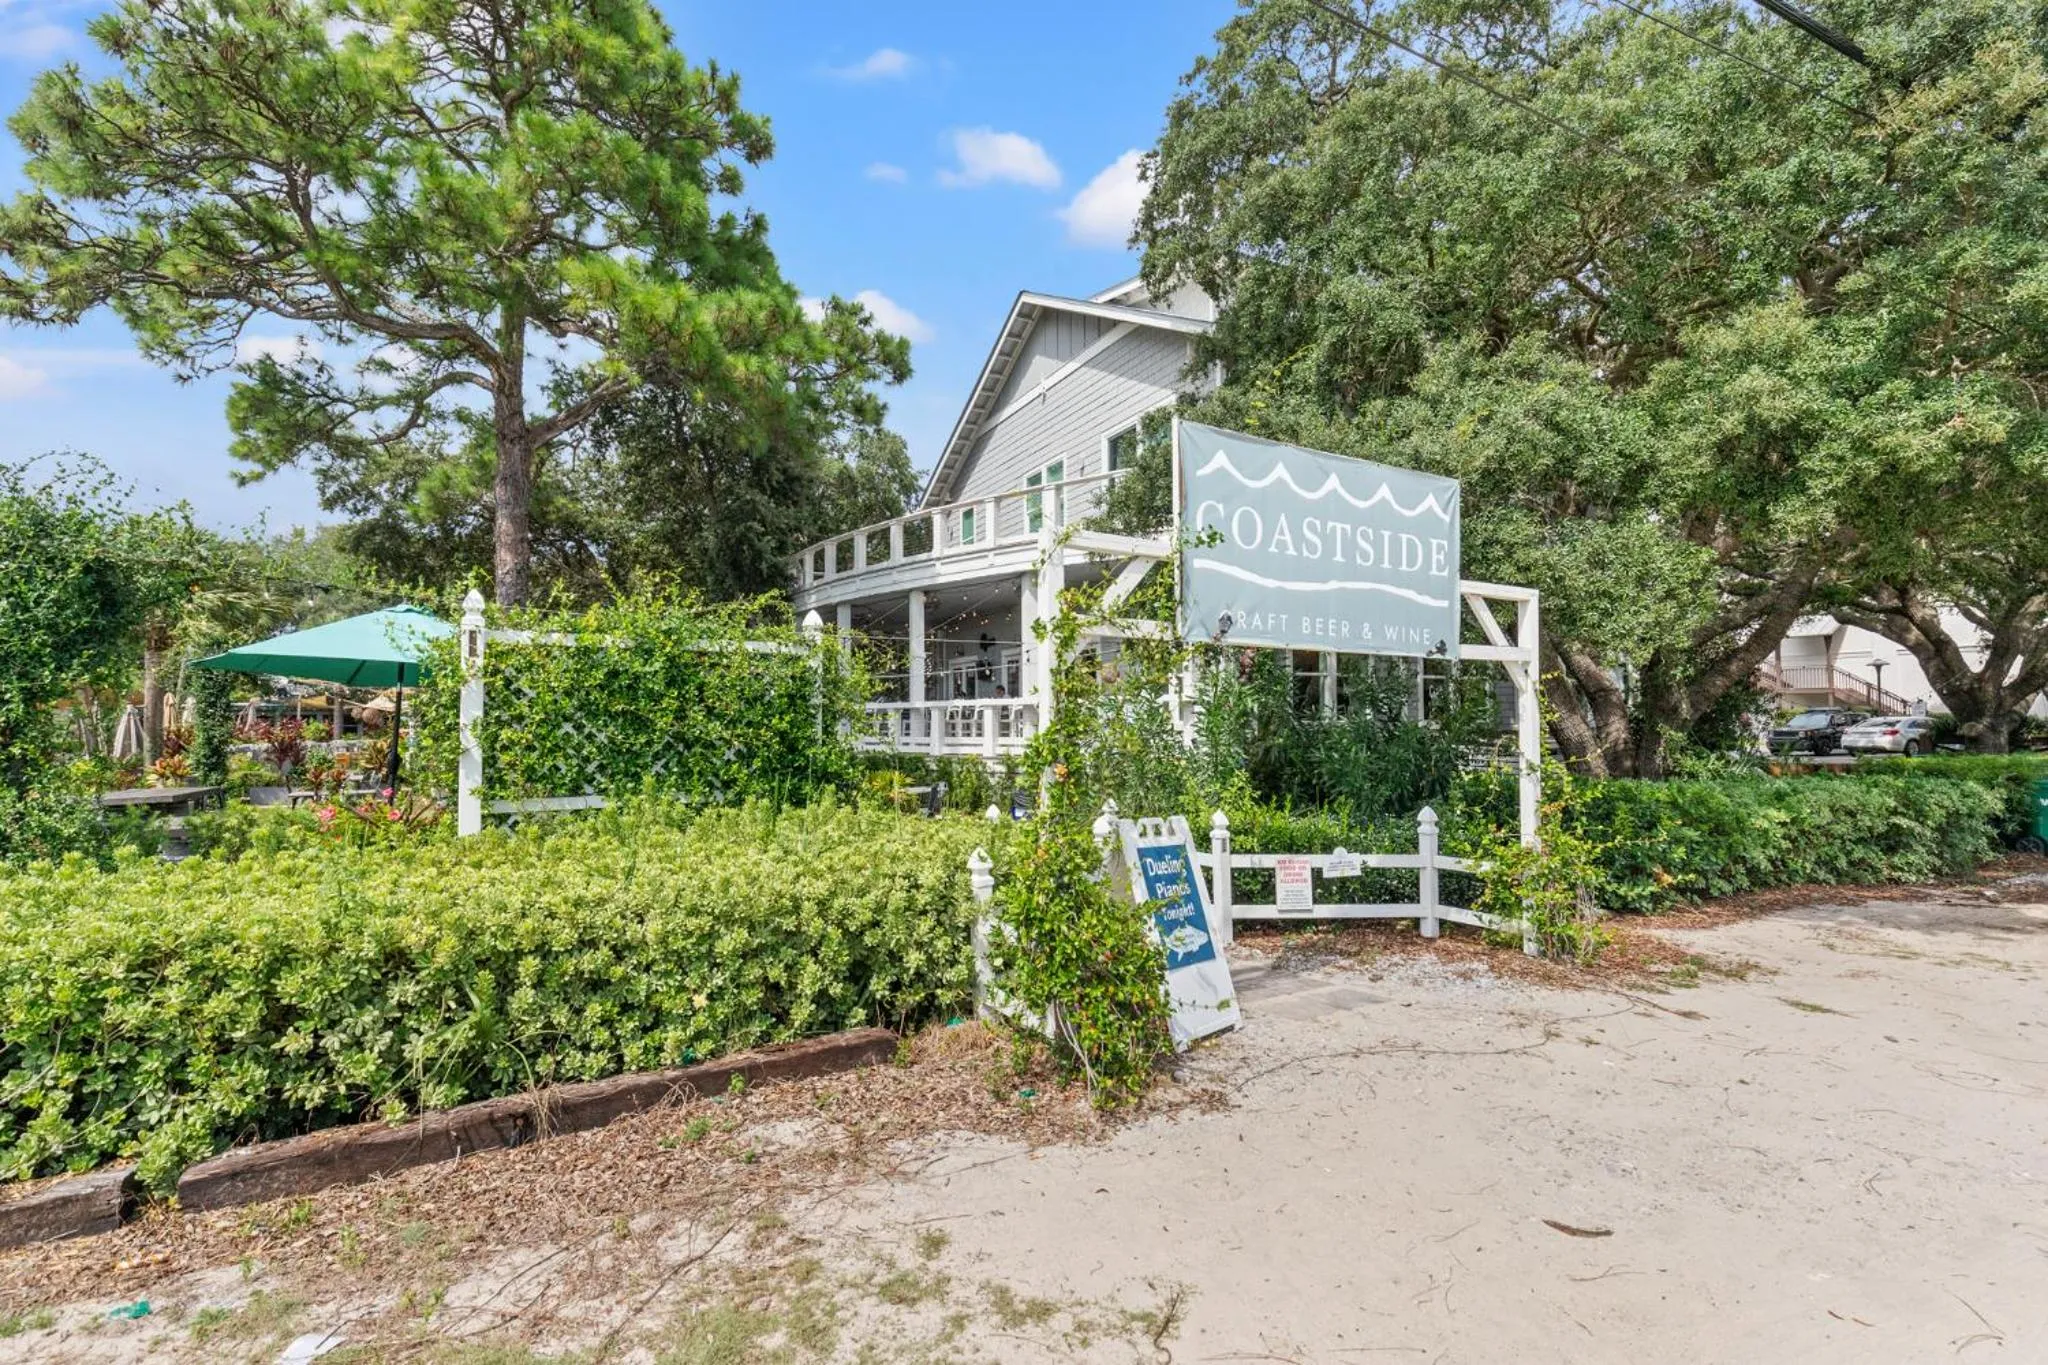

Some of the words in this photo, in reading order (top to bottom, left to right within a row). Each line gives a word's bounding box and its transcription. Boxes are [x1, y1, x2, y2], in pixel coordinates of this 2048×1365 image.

[1196, 500, 1449, 577] COASTSIDE
[1219, 609, 1288, 633] RAFT
[1302, 616, 1350, 638] BEER
[1363, 622, 1372, 640] &
[1384, 624, 1431, 645] WINE
